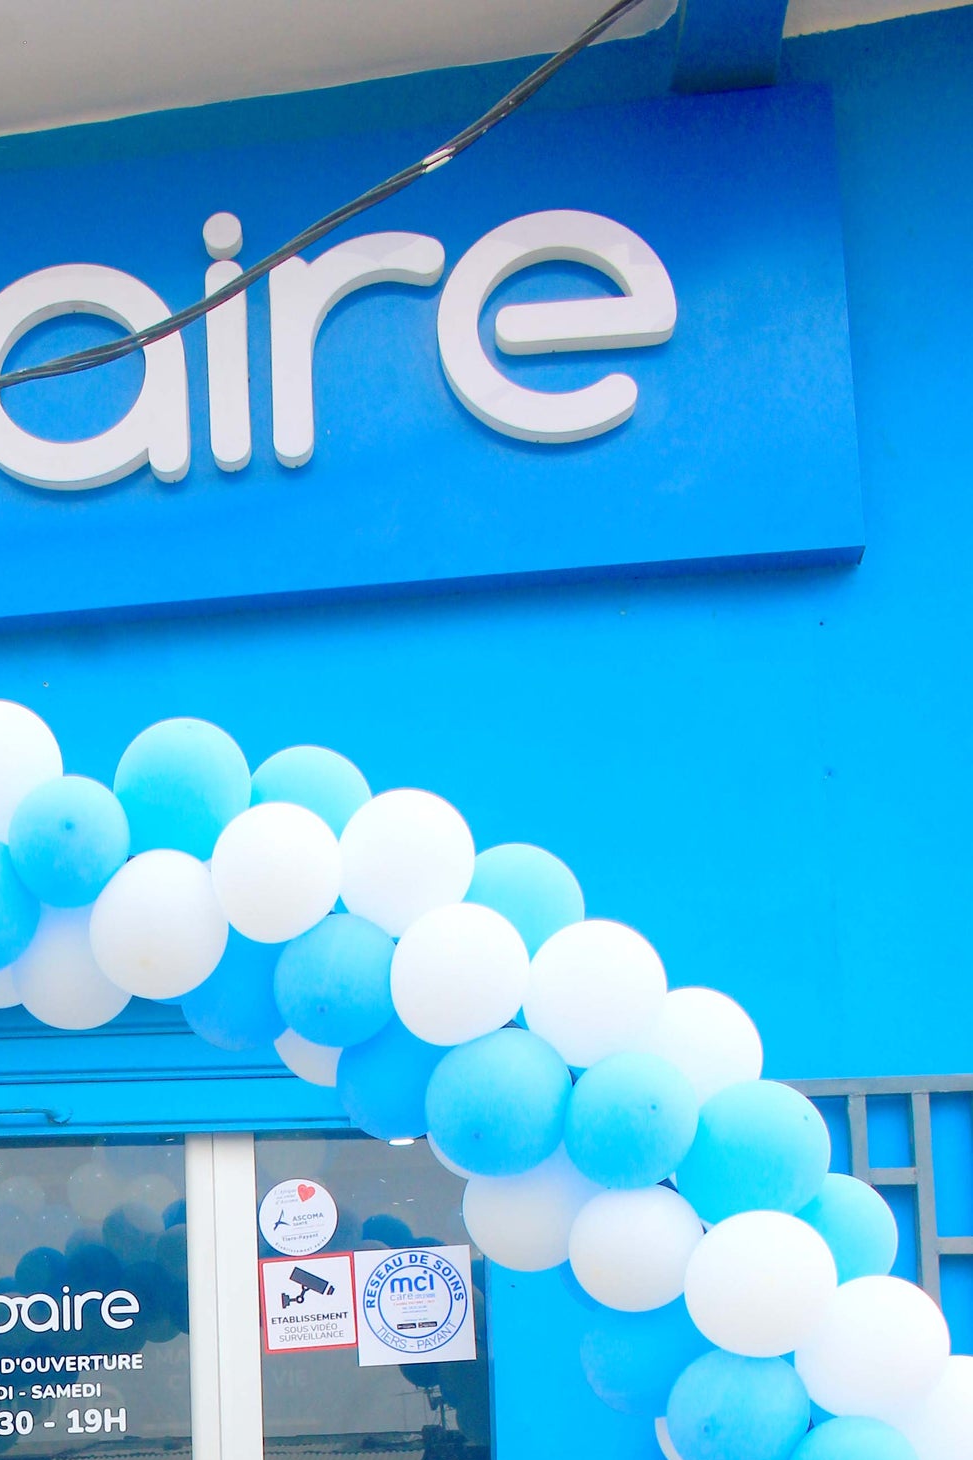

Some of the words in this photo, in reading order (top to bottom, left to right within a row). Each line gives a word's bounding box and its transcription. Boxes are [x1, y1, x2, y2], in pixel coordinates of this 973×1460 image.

[292, 1212, 324, 1222] ASCOMA
[367, 1256, 403, 1309] RESEAU
[409, 1254, 429, 1265] DE
[433, 1260, 464, 1301] SOINS
[390, 1270, 435, 1293] mci
[271, 1312, 348, 1325] ETABLISSEMENT
[284, 1326, 309, 1334] SOUS
[310, 1322, 338, 1332] VIDÉO
[279, 1330, 344, 1342] SURVEILLANCE
[377, 1325, 407, 1349] TIERS
[417, 1320, 456, 1350] PAYANT
[0, 1353, 144, 1375] D'OUVERTURE
[31, 1383, 102, 1400] SAMEDI
[67, 1407, 127, 1434] 19H
